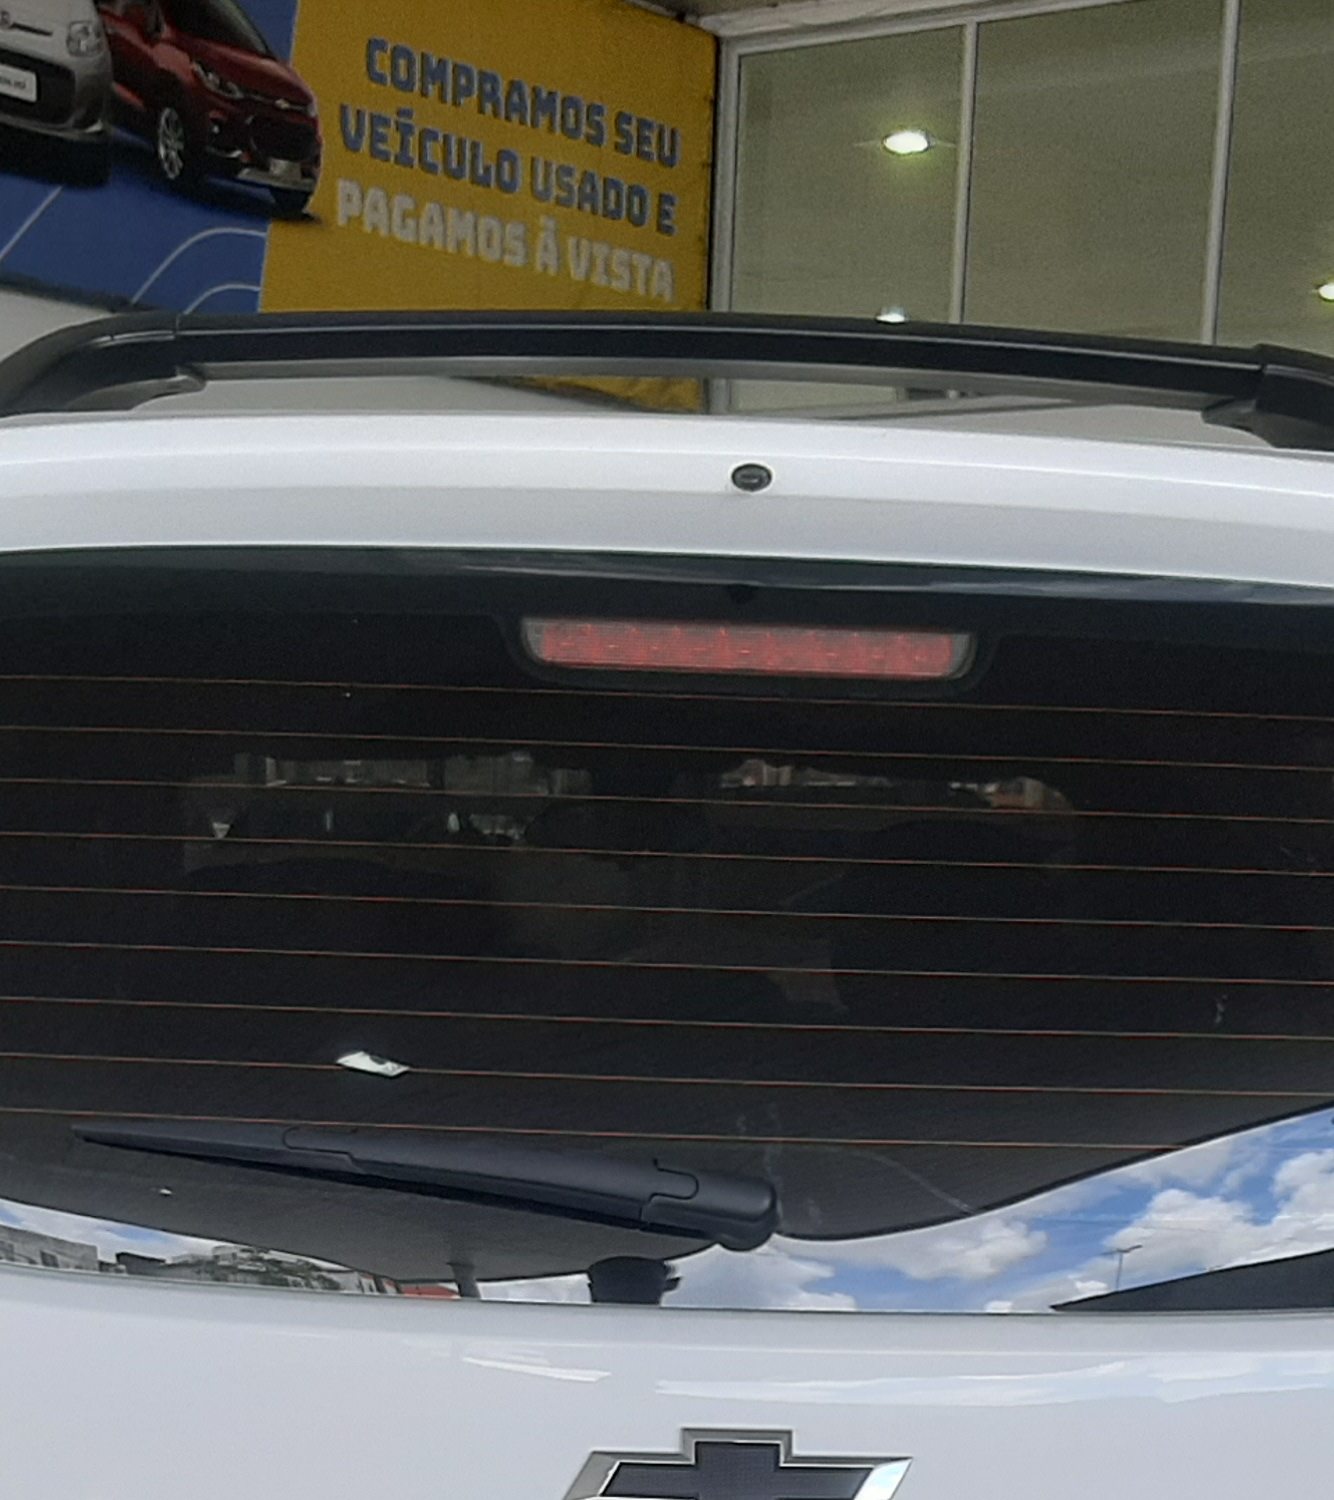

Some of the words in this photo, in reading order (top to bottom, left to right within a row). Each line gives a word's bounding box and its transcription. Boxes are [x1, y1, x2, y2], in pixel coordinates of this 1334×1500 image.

[366, 38, 608, 147] COMPRAMOS
[616, 110, 682, 168] SEU
[341, 103, 522, 193] VEÍCULO
[531, 156, 650, 227] USADO
[658, 193, 679, 236] E
[336, 178, 529, 267] PAGAMOS
[535, 215, 561, 276] À
[568, 236, 675, 302] VISTA
